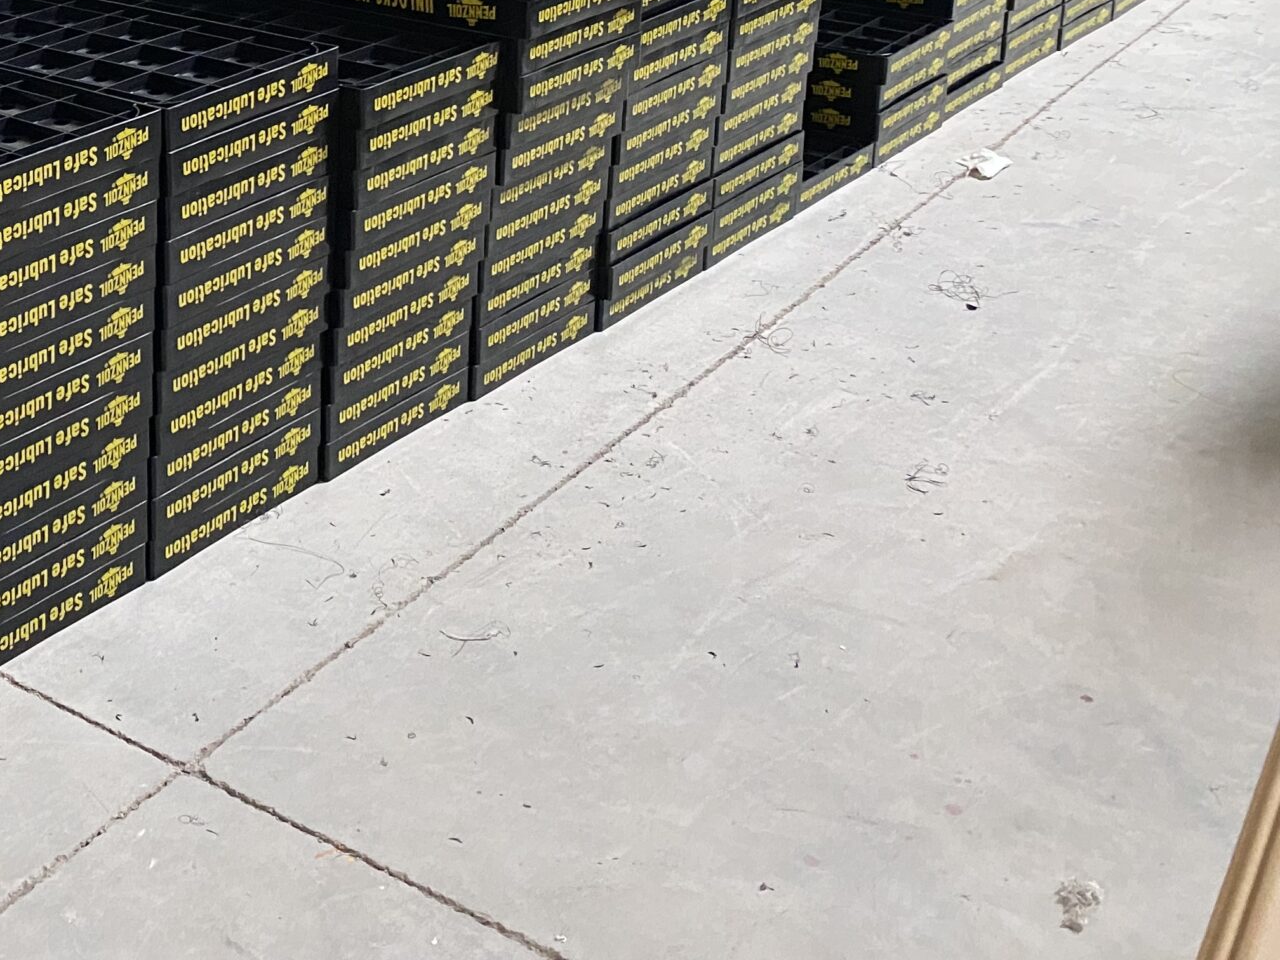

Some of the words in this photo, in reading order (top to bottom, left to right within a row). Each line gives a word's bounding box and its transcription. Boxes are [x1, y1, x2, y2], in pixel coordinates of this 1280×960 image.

[291, 65, 329, 91] PENNZOIL
[438, 66, 462, 88] Safe
[257, 79, 286, 102] Safe
[374, 76, 436, 111] Lubrication
[183, 91, 255, 129] Lubrication
[433, 105, 457, 126] Safe
[106, 130, 148, 160] PENNZOIL
[369, 115, 431, 152] Lubrication
[64, 148, 97, 171] Safe
[289, 191, 327, 217] PENNZOIL
[255, 208, 283, 230] Safe
[103, 222, 144, 252] PENNZOIL
[180, 221, 251, 265] Lubrication
[60, 241, 94, 265] Safe
[97, 355, 142, 384] PENNZOIL
[56, 377, 89, 401] Safe
